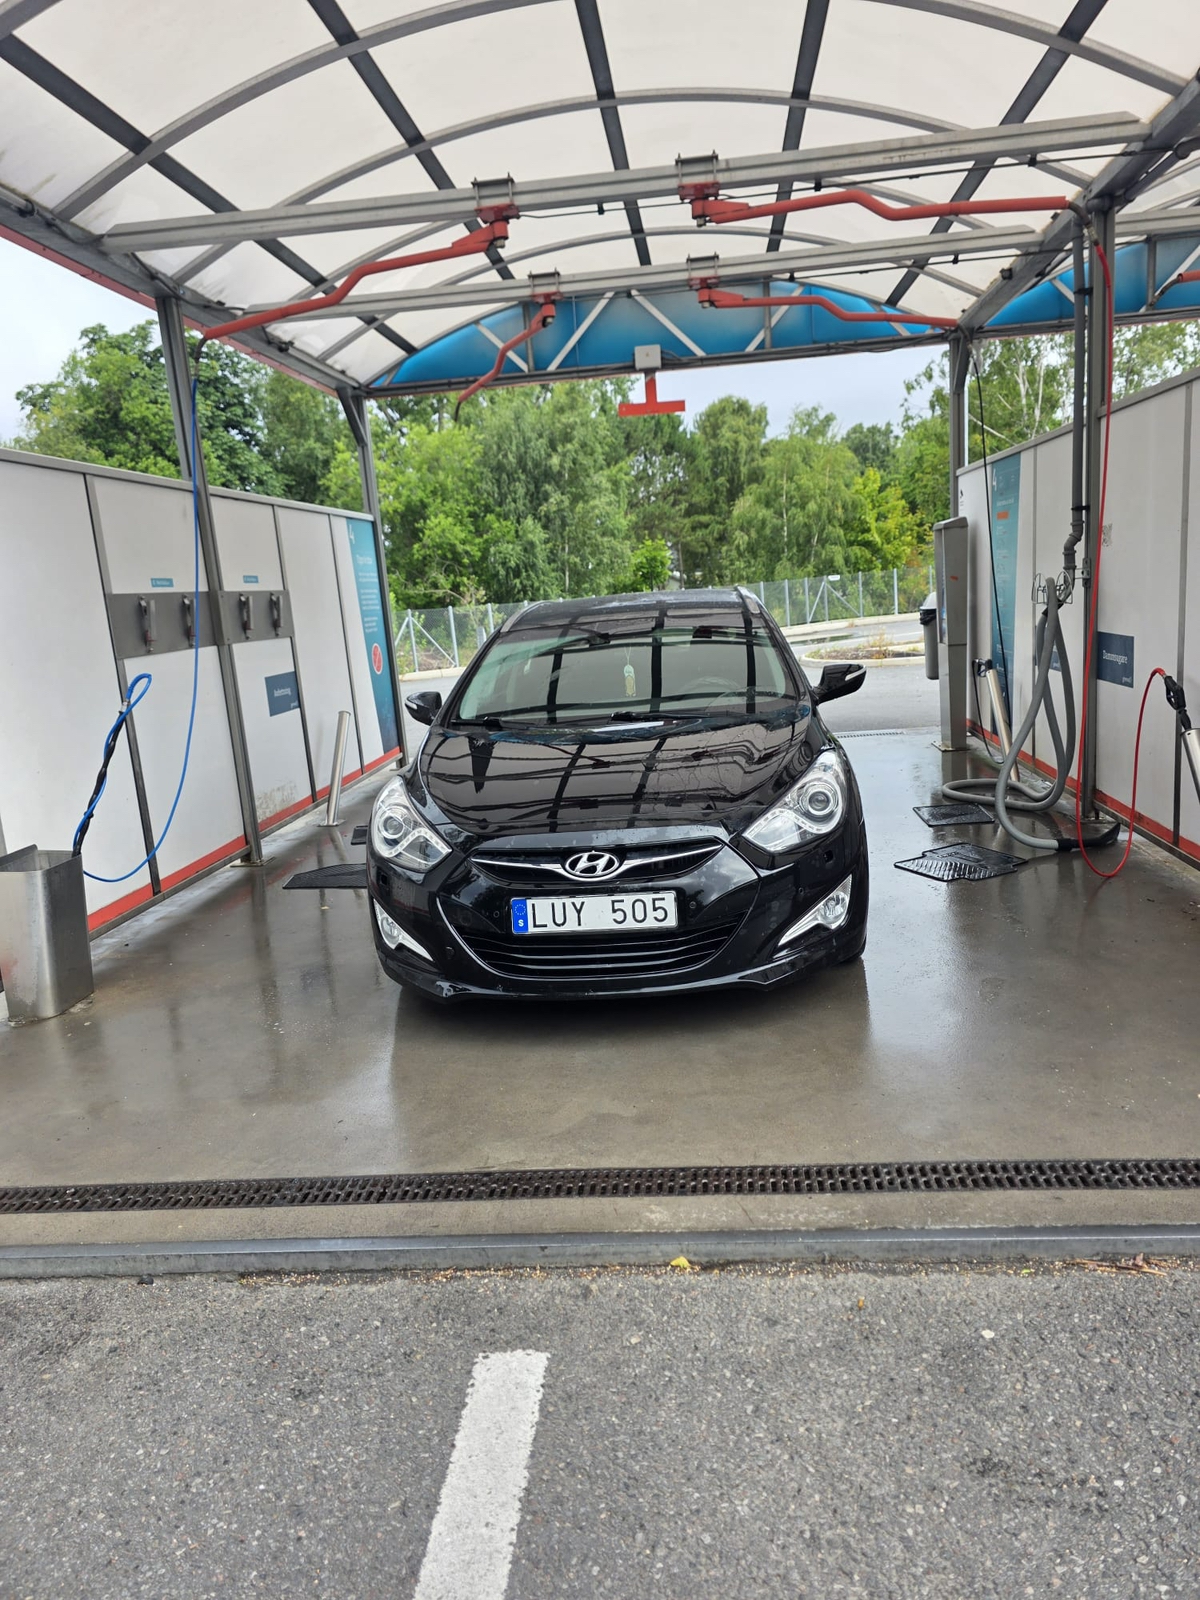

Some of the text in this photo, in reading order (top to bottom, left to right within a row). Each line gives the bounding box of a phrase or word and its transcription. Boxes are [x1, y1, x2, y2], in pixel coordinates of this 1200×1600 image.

[531, 897, 668, 928] LUY 505
[518, 919, 525, 927] S
